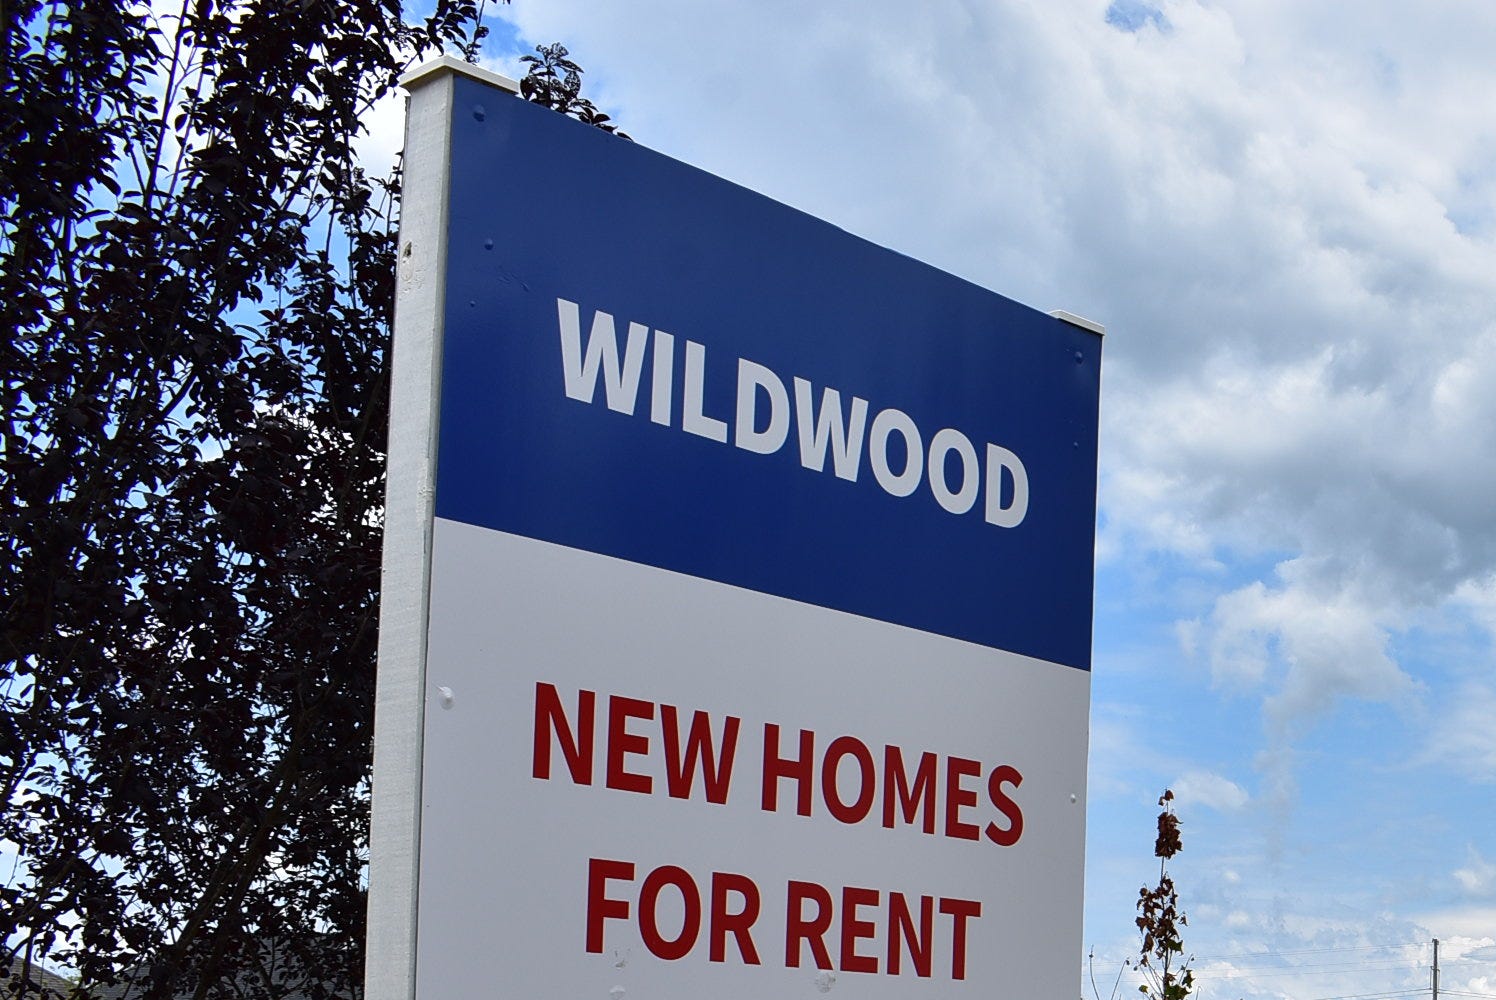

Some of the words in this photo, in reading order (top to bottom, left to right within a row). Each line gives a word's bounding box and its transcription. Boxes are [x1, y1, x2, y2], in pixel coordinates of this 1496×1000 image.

[556, 297, 1030, 529] WILDWOOD
[531, 681, 741, 805] NEW
[761, 722, 1024, 847] HOMES
[585, 857, 762, 966] FOR
[784, 879, 982, 981] RENT
